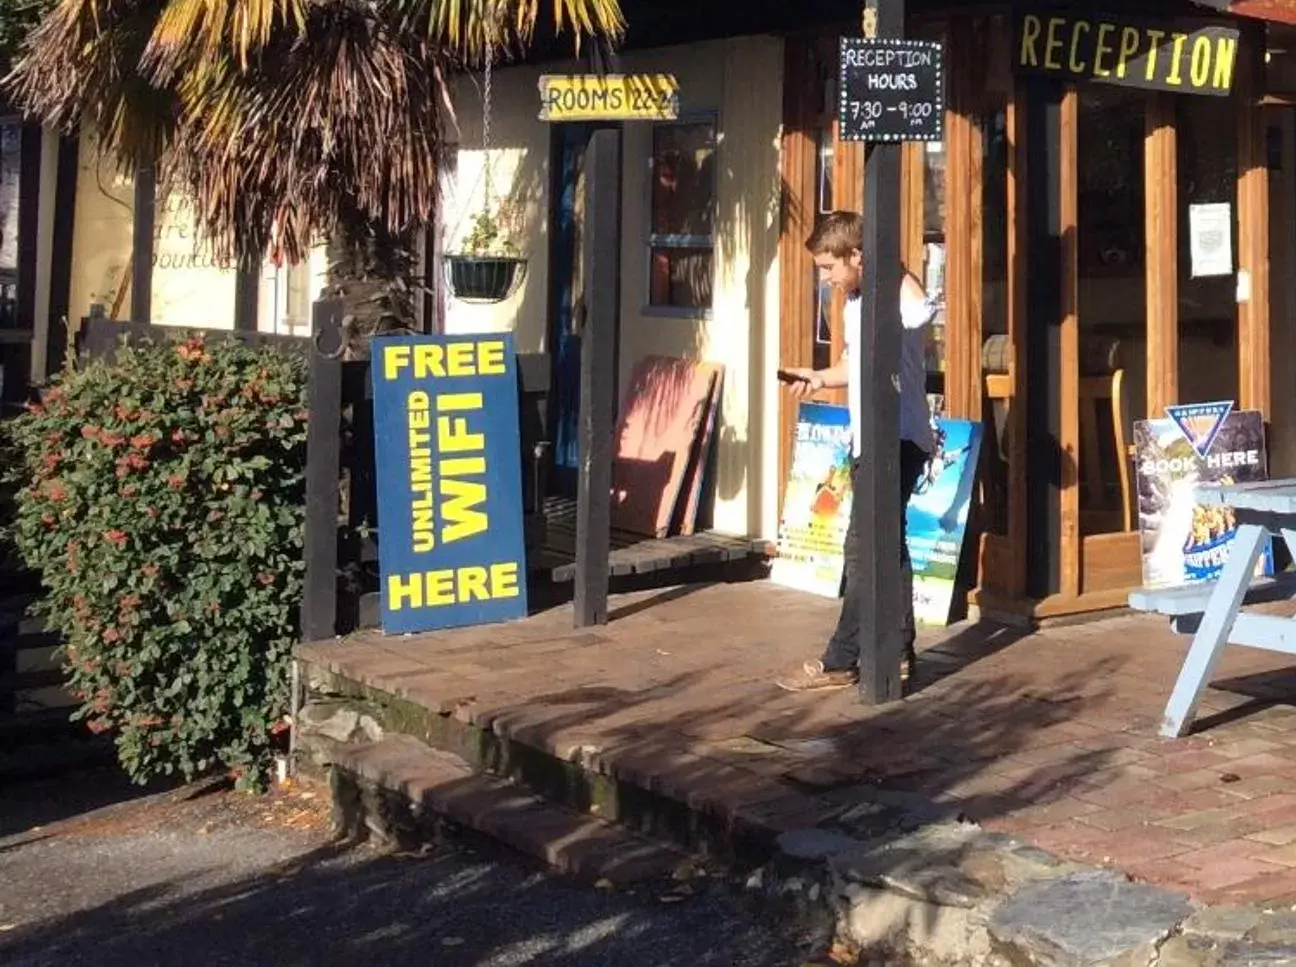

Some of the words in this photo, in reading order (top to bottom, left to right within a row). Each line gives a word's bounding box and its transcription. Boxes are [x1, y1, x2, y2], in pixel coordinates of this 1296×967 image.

[846, 48, 932, 67] RECEPTION
[1020, 15, 1236, 89] RECEPTION
[868, 73, 918, 89] HOURS
[548, 87, 623, 113] ROOMS
[850, 100, 882, 120] 7:30
[898, 101, 932, 119] 9:00
[383, 341, 506, 380] FREE
[407, 390, 435, 553] UNLIMITED
[436, 392, 489, 544] WIFI
[1141, 456, 1198, 476] BOOK
[1207, 449, 1260, 469] HERE
[388, 562, 520, 611] HERE
